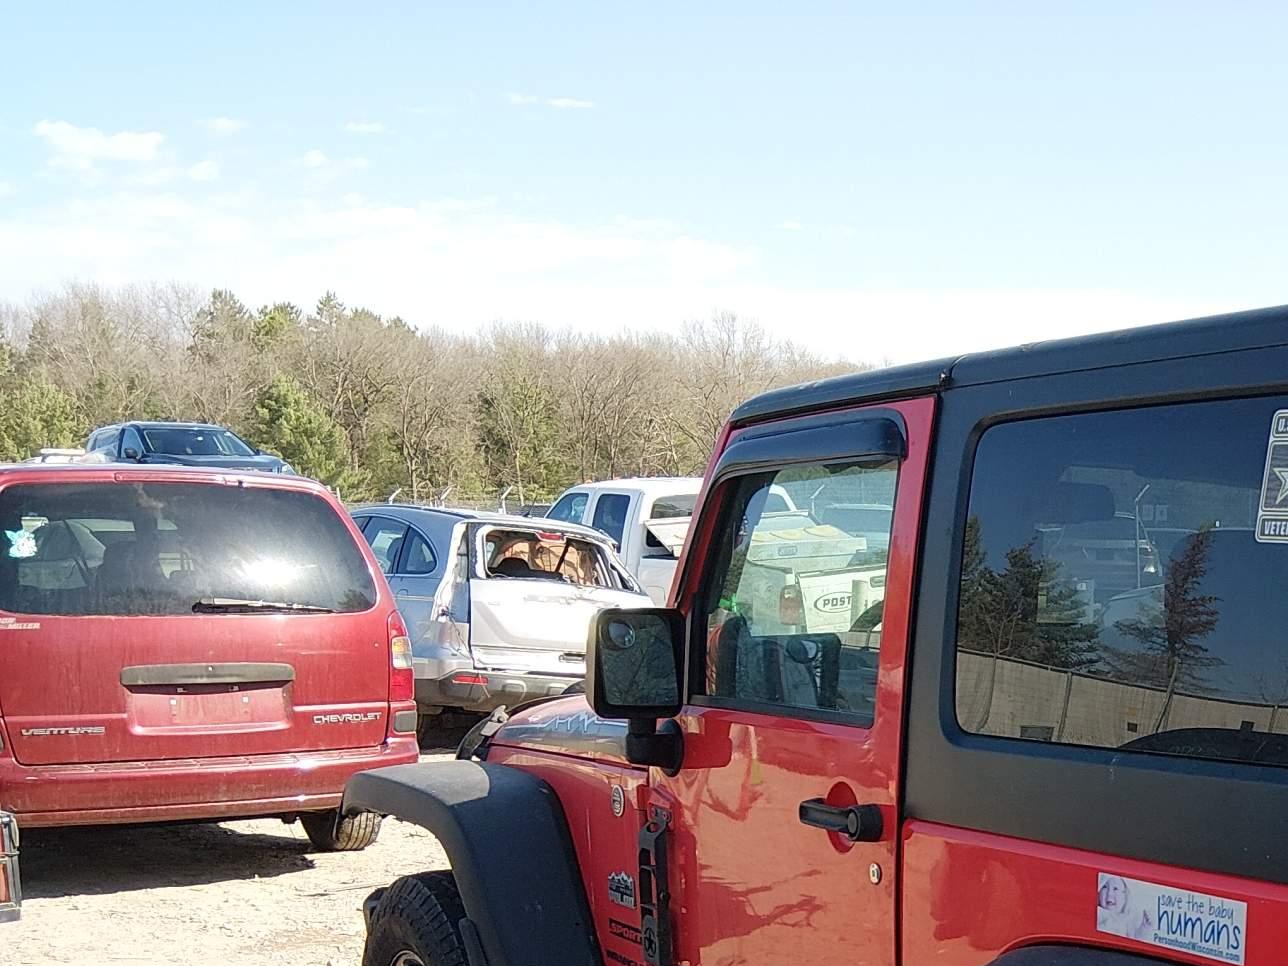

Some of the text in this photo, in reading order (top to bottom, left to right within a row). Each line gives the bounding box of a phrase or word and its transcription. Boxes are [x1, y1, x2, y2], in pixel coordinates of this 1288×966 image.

[313, 711, 382, 724] CHEVROLET
[21, 726, 105, 736] VENTURE
[1161, 893, 1234, 924] save the baby
[610, 921, 642, 944] SPORT
[1157, 896, 1241, 950] humans
